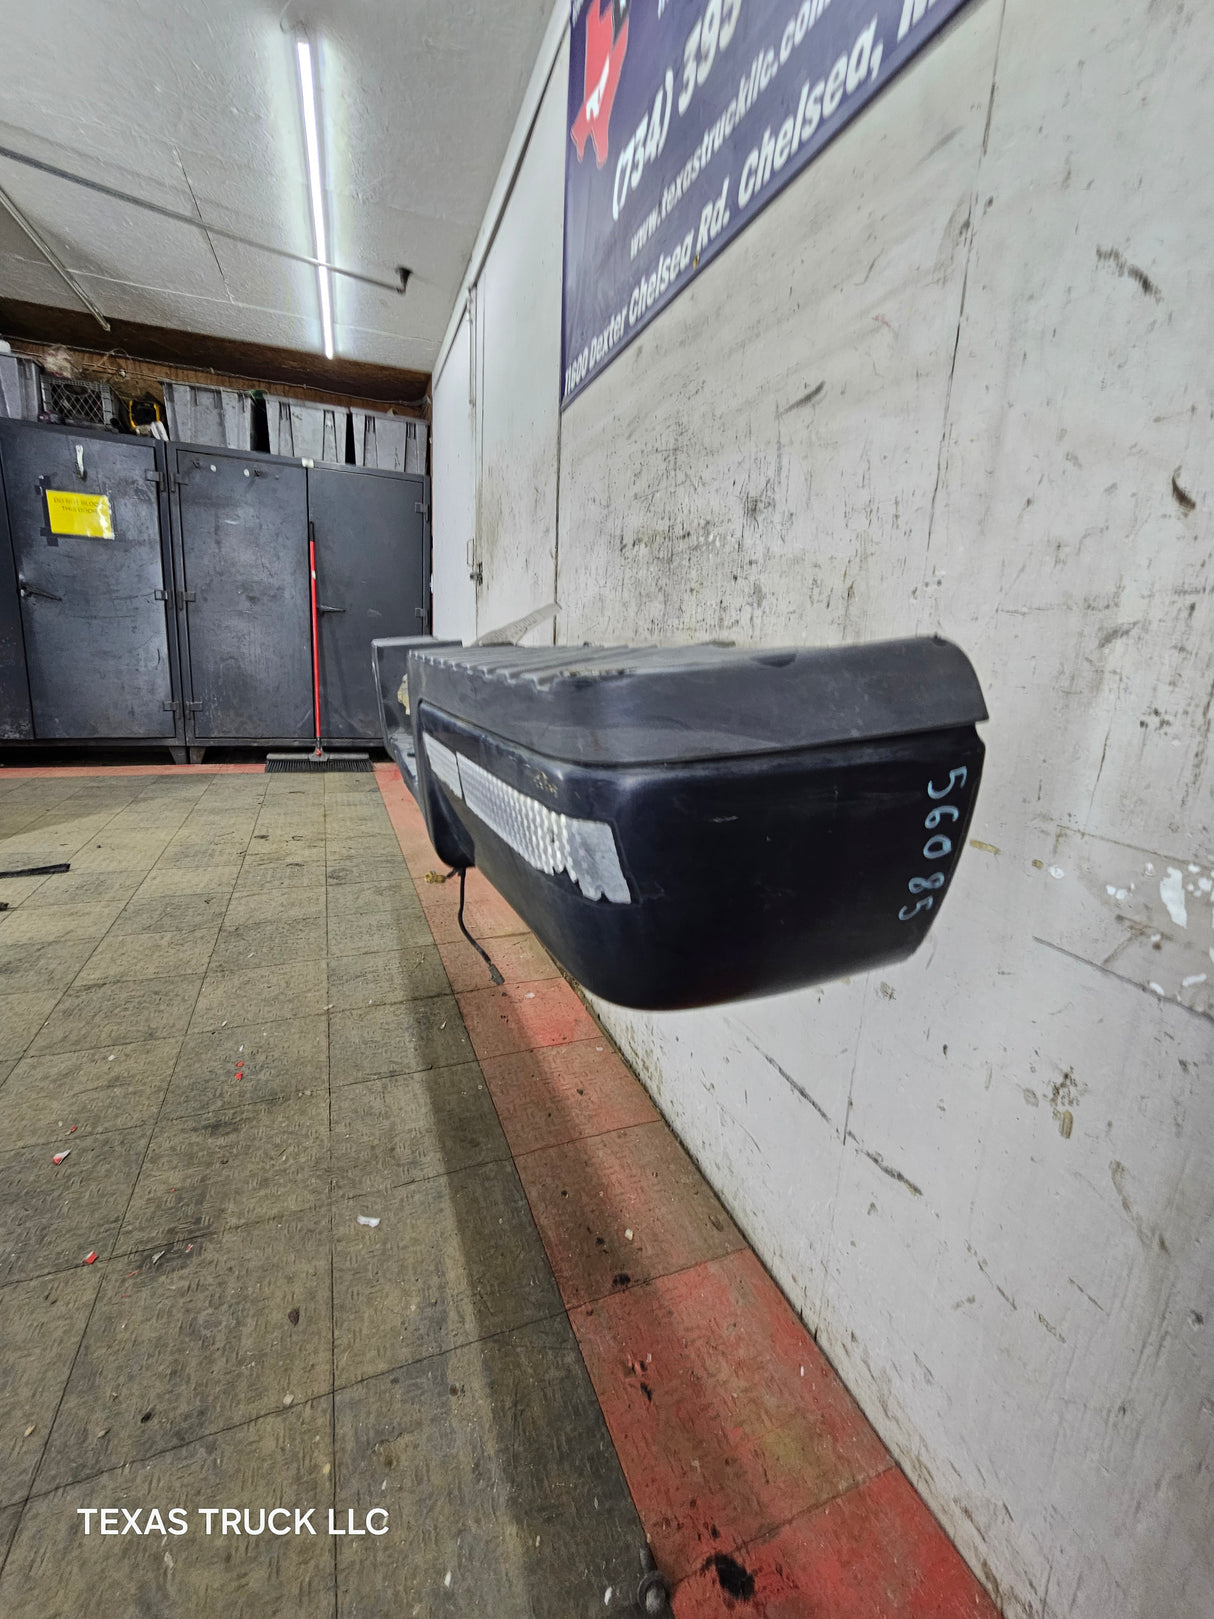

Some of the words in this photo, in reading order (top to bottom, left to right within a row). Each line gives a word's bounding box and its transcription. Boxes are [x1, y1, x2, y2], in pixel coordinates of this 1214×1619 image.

[565, 346, 588, 397] 11600
[589, 304, 628, 371] Dexter
[629, 228, 694, 327] Chelsea
[696, 174, 730, 254] Rd.
[738, 12, 883, 209] Chelsea,
[612, 67, 674, 221] (734)
[898, 765, 968, 922] 56085
